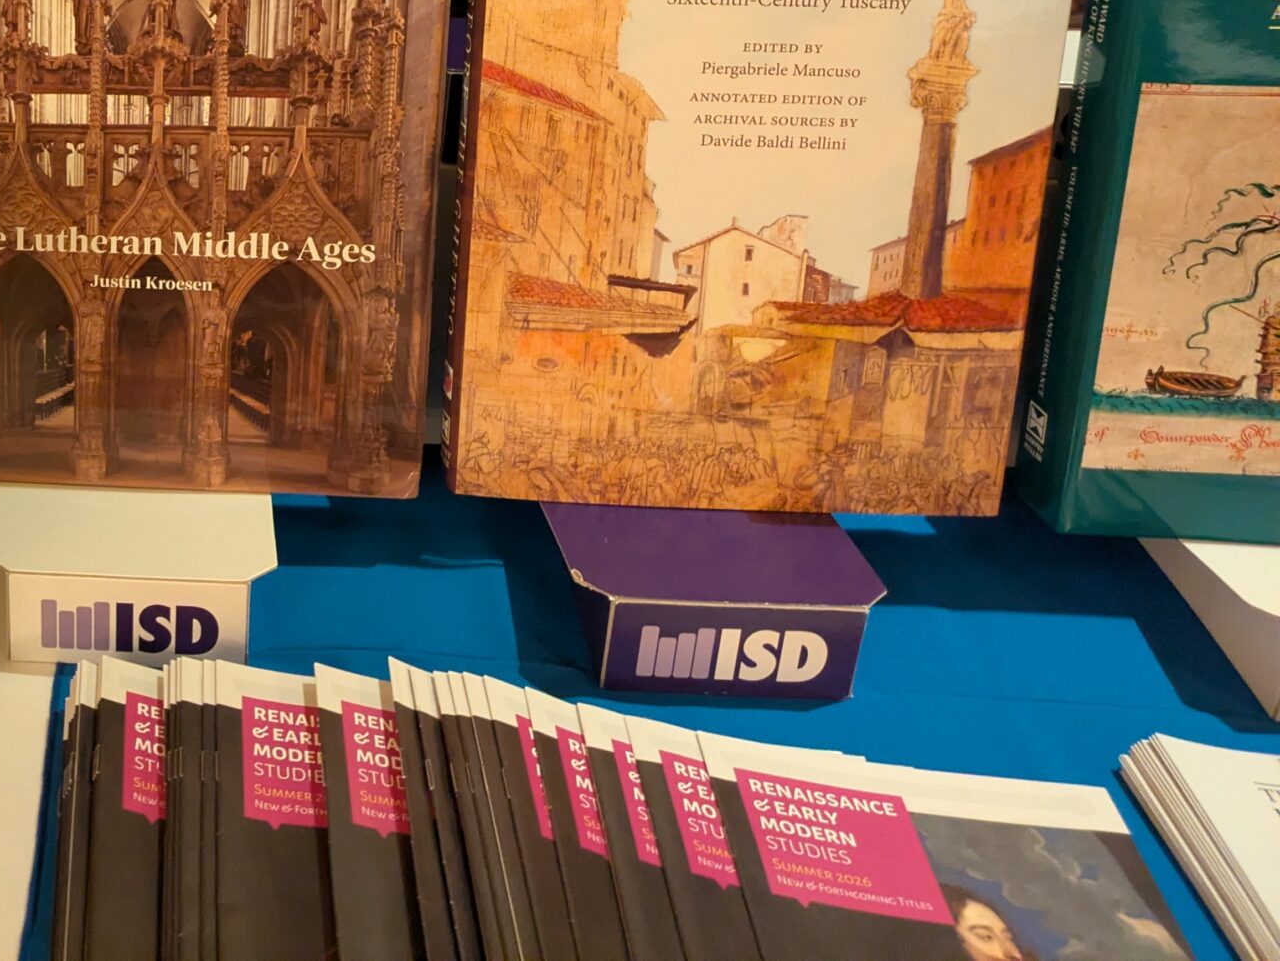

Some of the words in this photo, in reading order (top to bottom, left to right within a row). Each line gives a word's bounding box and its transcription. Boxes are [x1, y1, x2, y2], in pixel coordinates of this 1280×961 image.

[743, 43, 799, 53] EDITED
[804, 44, 823, 53] BY
[702, 61, 788, 79] Piergabriele
[792, 63, 861, 78] Mancuso
[15, 226, 164, 256] Lutheran
[172, 229, 289, 261] Middle
[295, 236, 376, 270] Ages
[90, 274, 141, 289] Justin
[146, 276, 212, 291] Kroesen
[116, 602, 219, 655] ISD
[714, 628, 828, 683] ISD
[748, 778, 898, 817] RENAISSANCE
[753, 799, 771, 811] &
[774, 801, 838, 826] EARLY
[760, 816, 857, 847] MODERN
[766, 835, 852, 865] STUDIES
